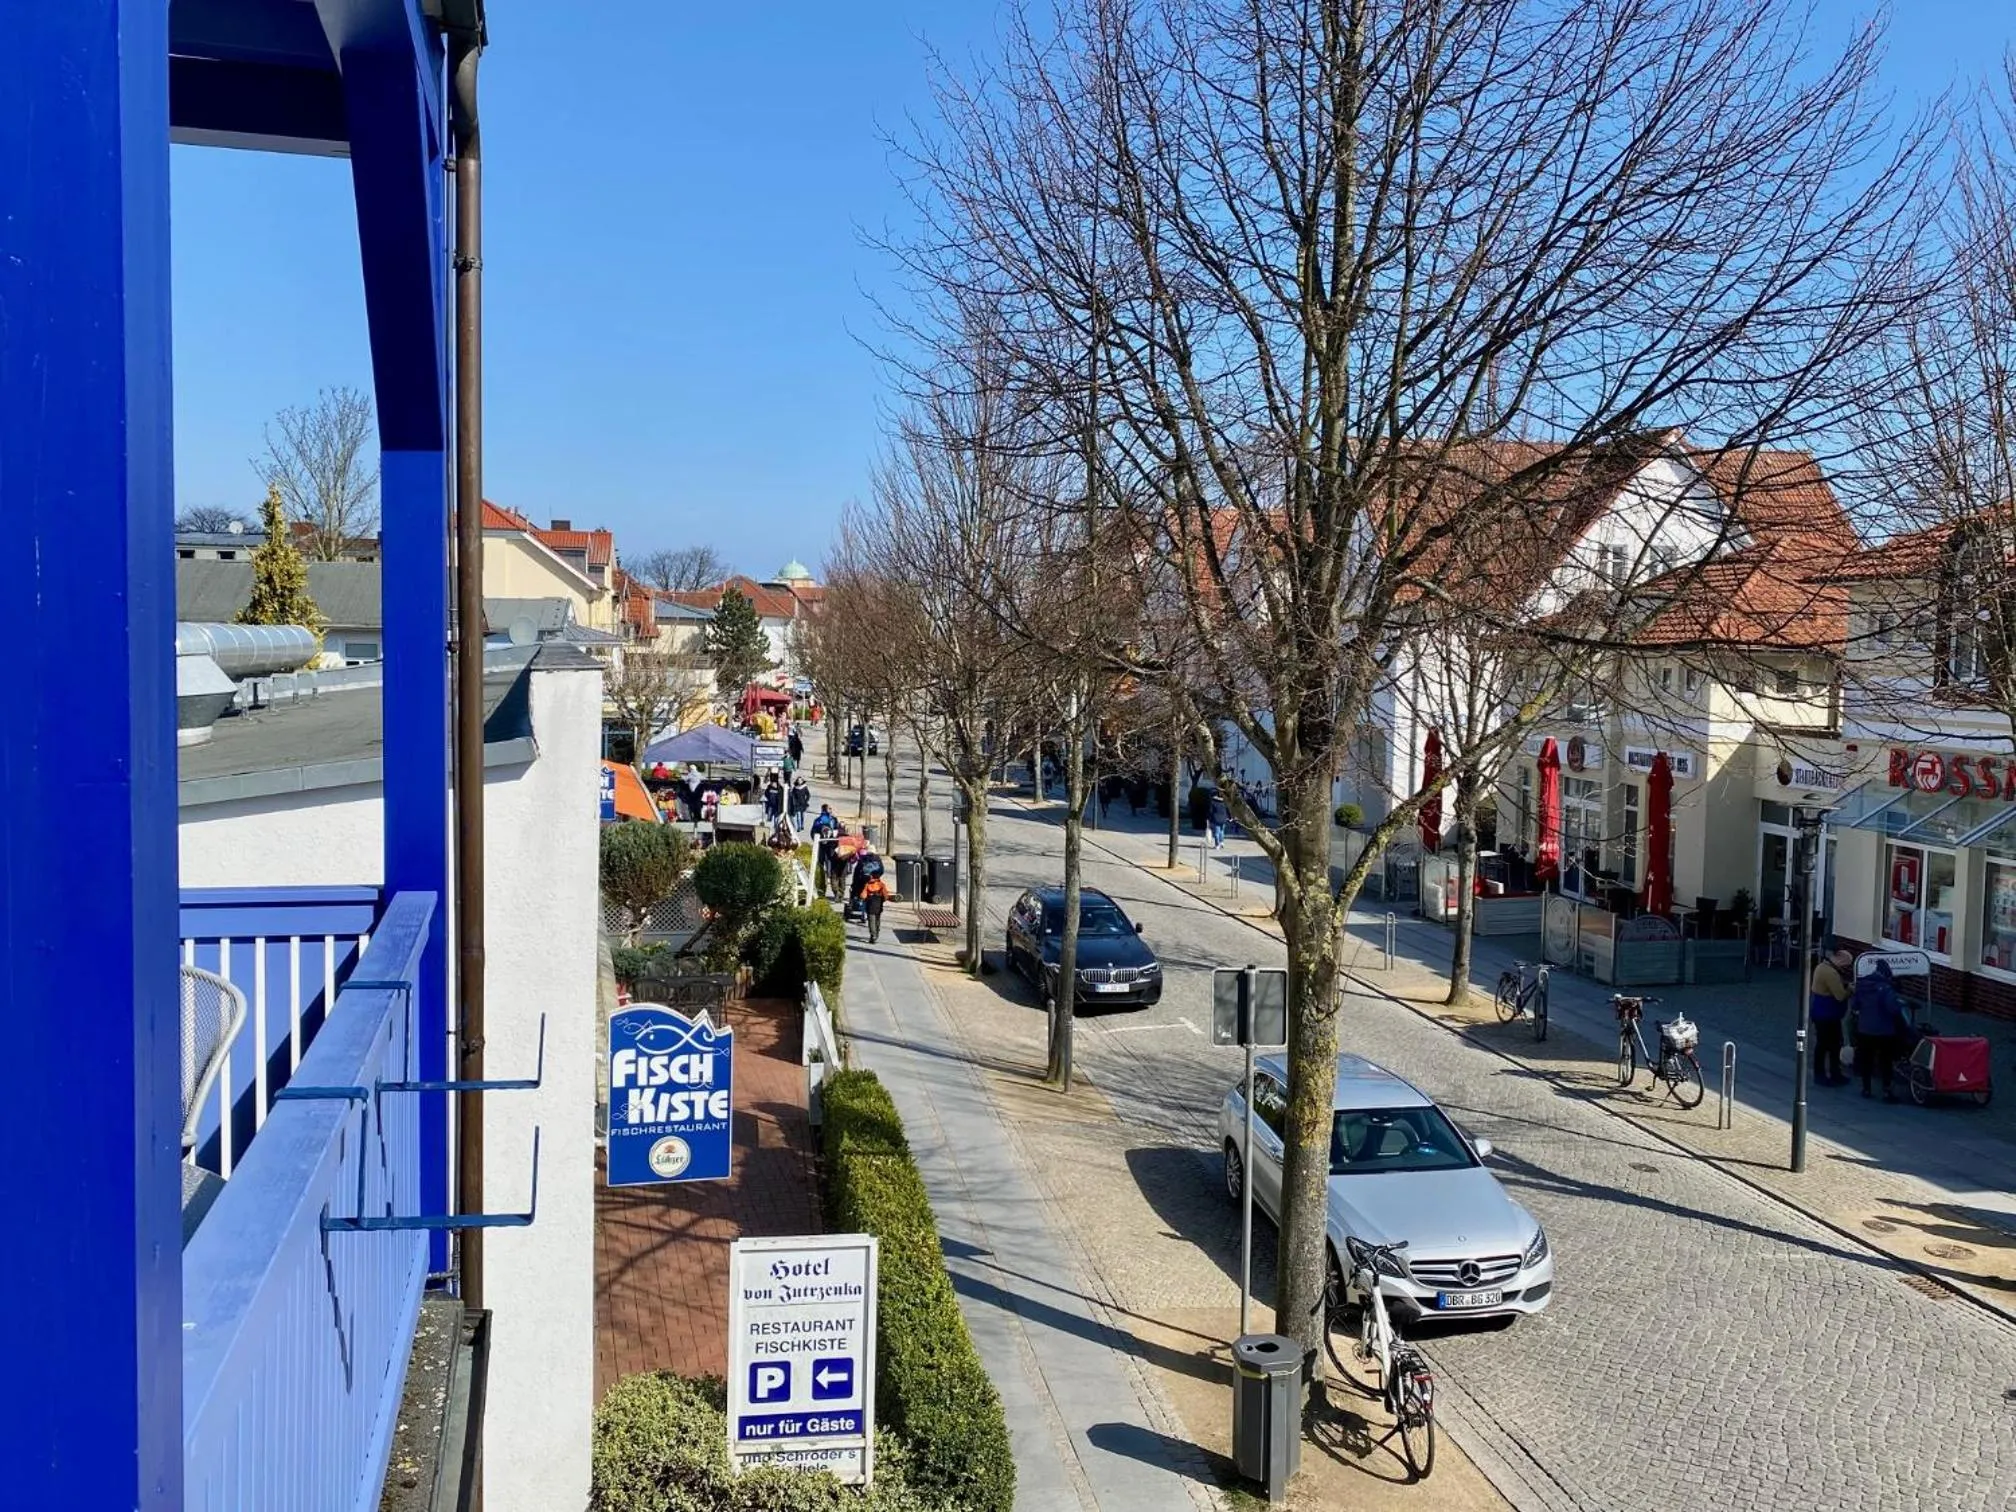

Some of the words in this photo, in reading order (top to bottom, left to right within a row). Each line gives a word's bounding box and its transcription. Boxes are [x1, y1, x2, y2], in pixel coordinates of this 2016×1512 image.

[612, 1048, 714, 1088] FISCH
[627, 1087, 729, 1125] KISTE
[611, 1121, 728, 1137] FISCHRESTAURANT
[769, 1257, 830, 1281] Hotel
[743, 1288, 773, 1301] von
[1446, 1295, 1465, 1306] DBR
[750, 1318, 856, 1336] RESTAURANT
[755, 1337, 848, 1354] FISCHKISTE
[756, 1367, 786, 1399] P
[745, 1423, 775, 1437] nur
[778, 1419, 803, 1434] für
[806, 1417, 856, 1433] Gäste
